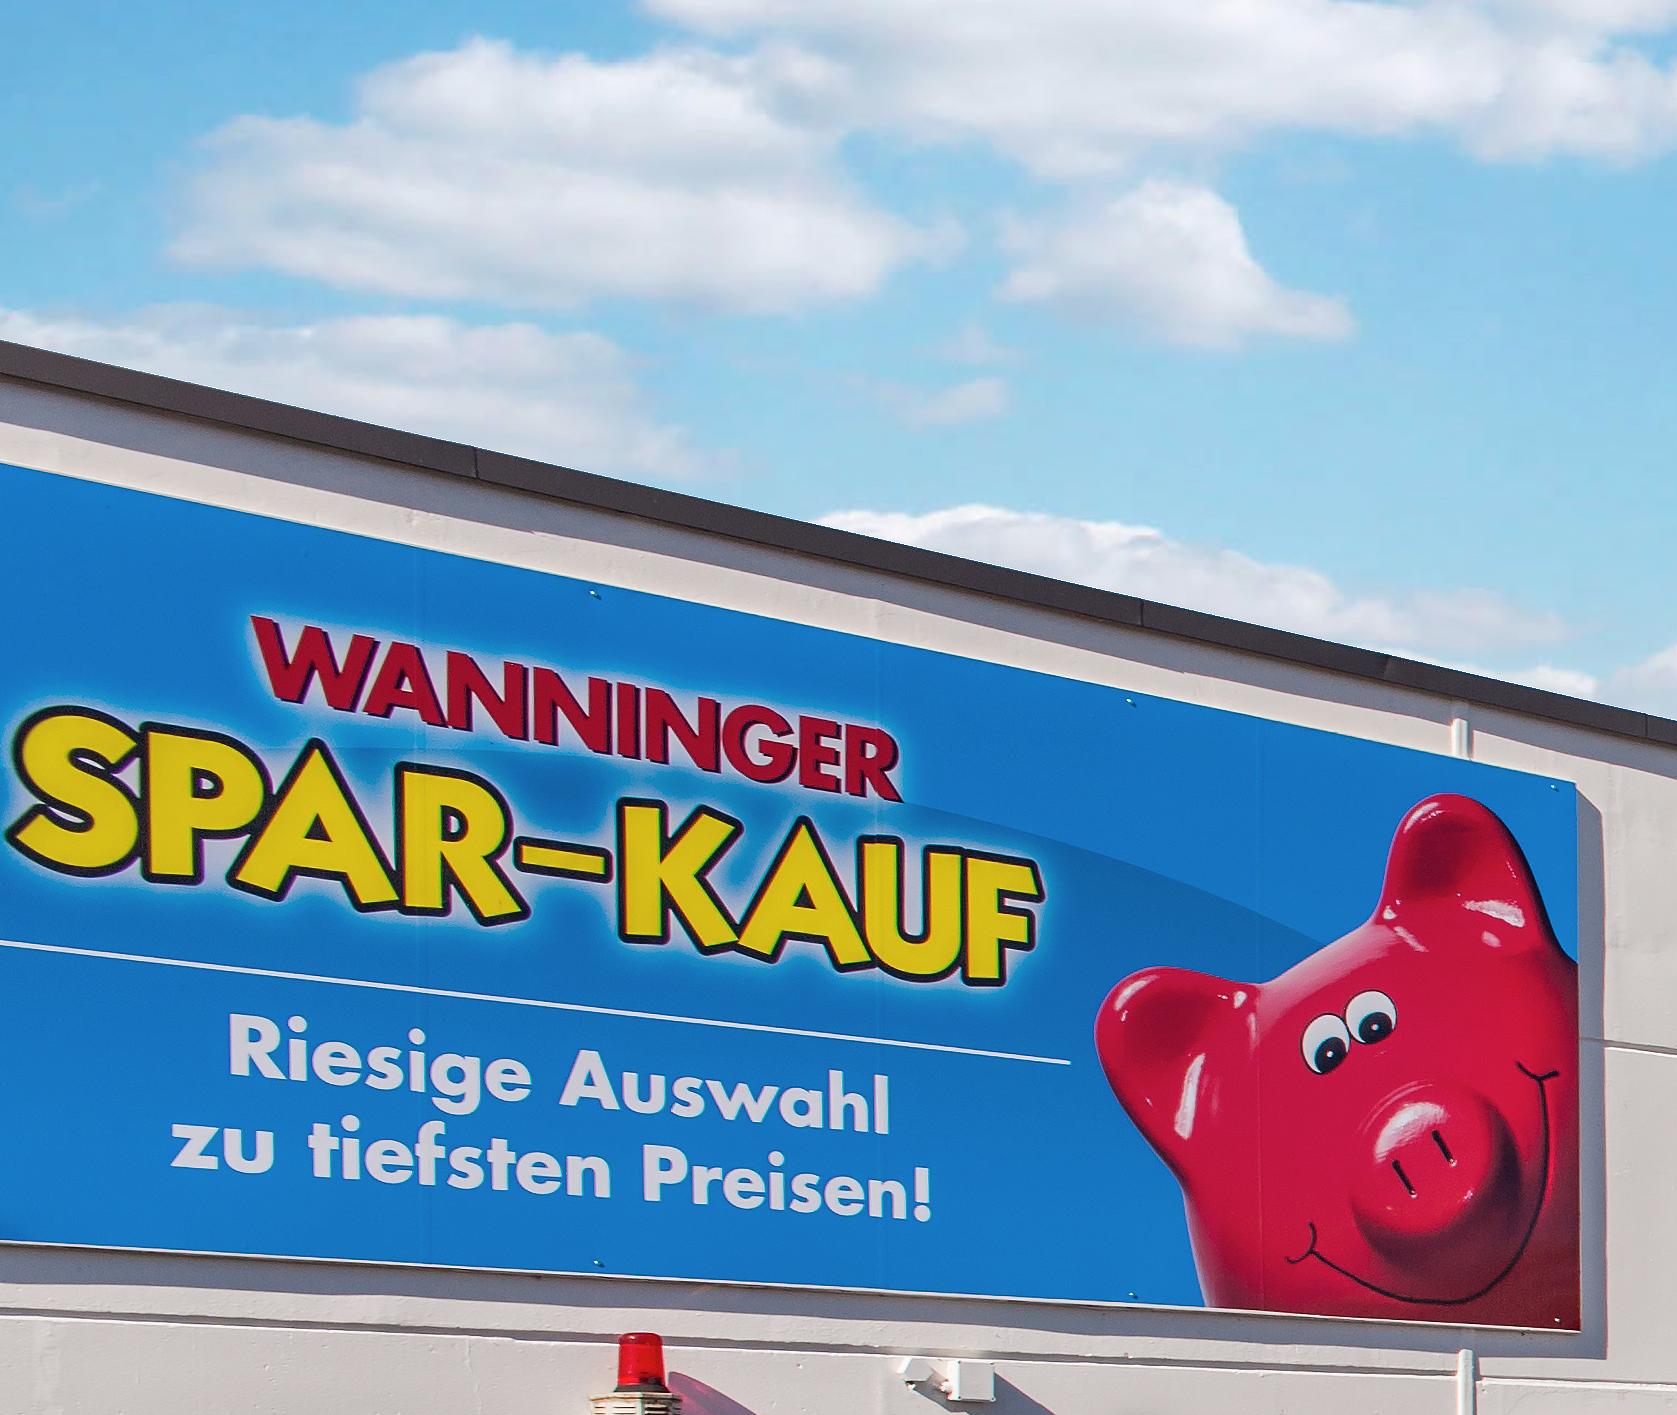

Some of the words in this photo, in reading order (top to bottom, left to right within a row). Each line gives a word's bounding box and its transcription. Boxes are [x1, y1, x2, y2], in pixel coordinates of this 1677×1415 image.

[249, 614, 904, 803] WANNINGER
[5, 705, 1046, 986] SPAR-KAUF
[229, 1014, 532, 1115] Riesige
[559, 1048, 890, 1136] Auswahl
[170, 1121, 275, 1175] zu
[308, 1115, 611, 1199] tiefsten
[643, 1143, 933, 1222] Preisen!
